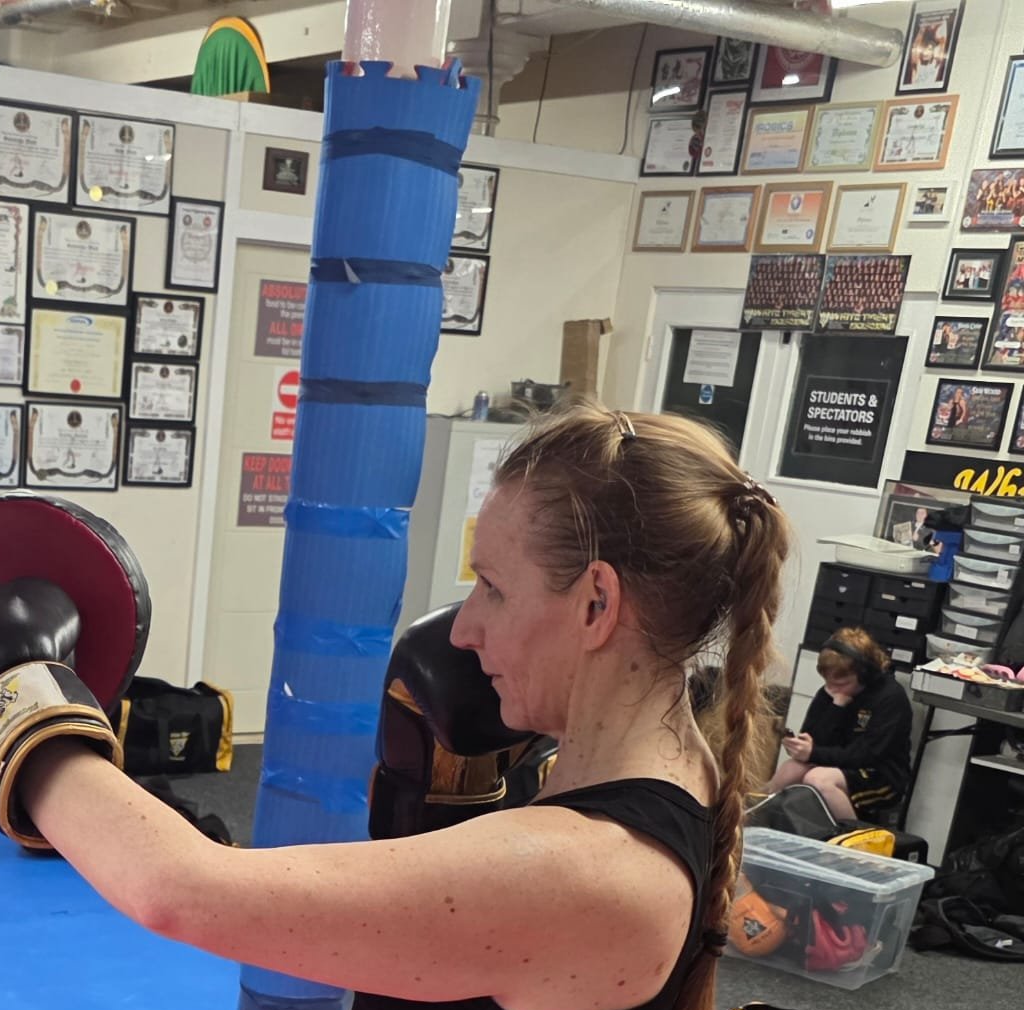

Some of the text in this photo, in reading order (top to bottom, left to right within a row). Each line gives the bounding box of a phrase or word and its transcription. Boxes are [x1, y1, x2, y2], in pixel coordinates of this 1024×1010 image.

[809, 390, 878, 407] STUDENTS &
[807, 406, 875, 424] SPECTATORS
[954, 465, 1024, 497] Wh
